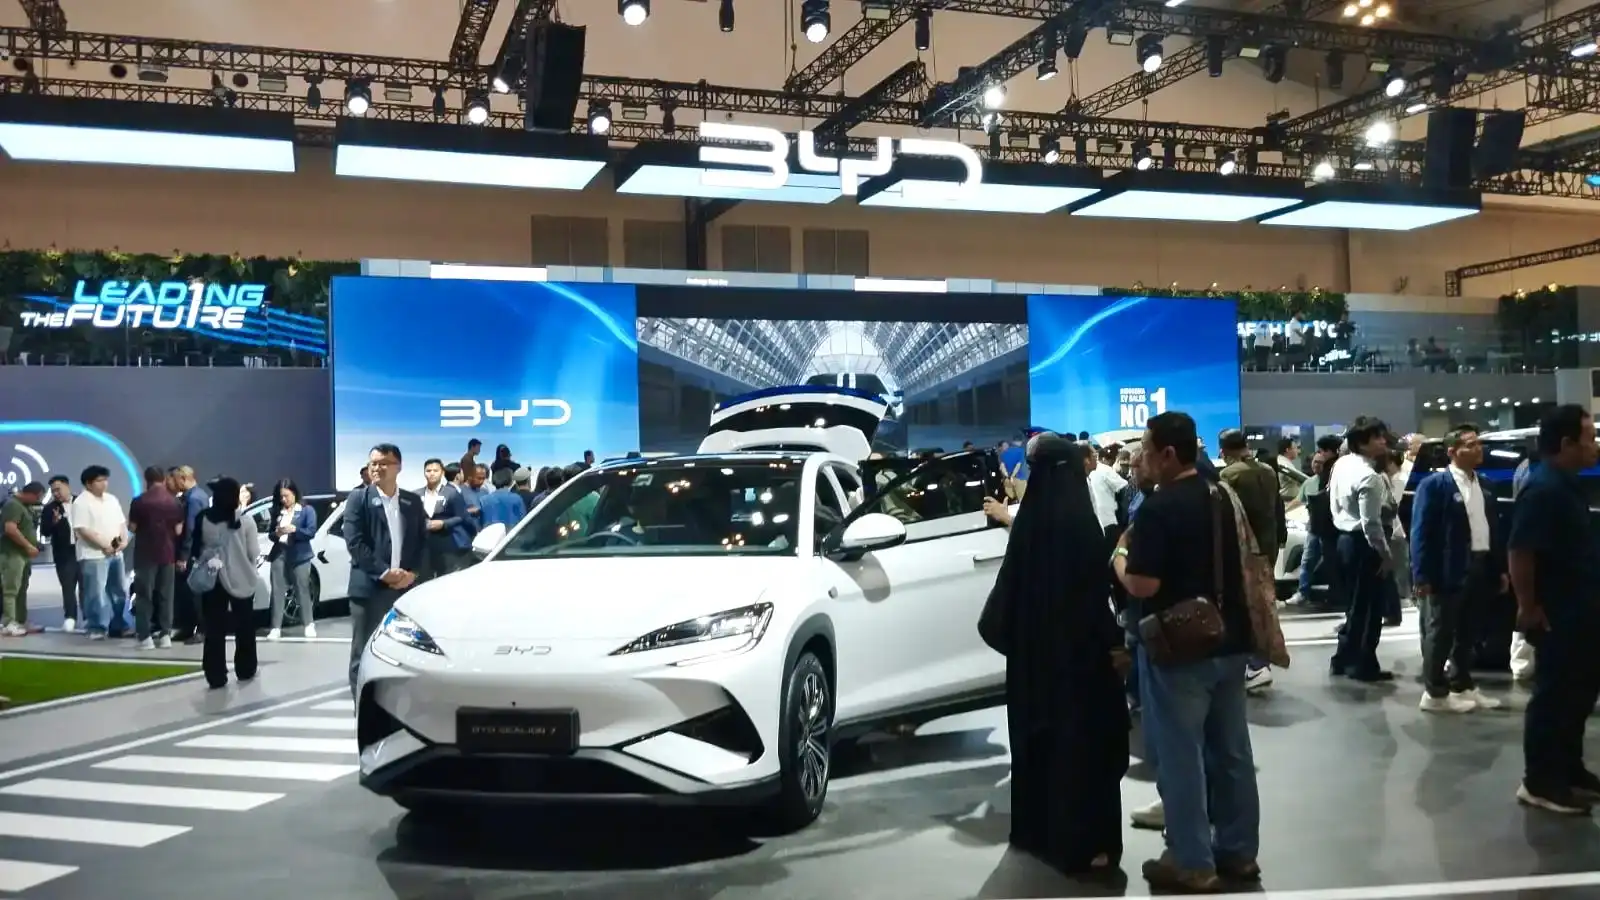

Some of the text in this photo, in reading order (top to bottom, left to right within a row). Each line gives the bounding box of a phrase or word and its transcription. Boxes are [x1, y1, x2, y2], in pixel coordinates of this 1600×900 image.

[699, 121, 983, 200] BYD
[20, 311, 64, 328] THE
[439, 398, 572, 428] BYD
[494, 645, 552, 656] BYD
